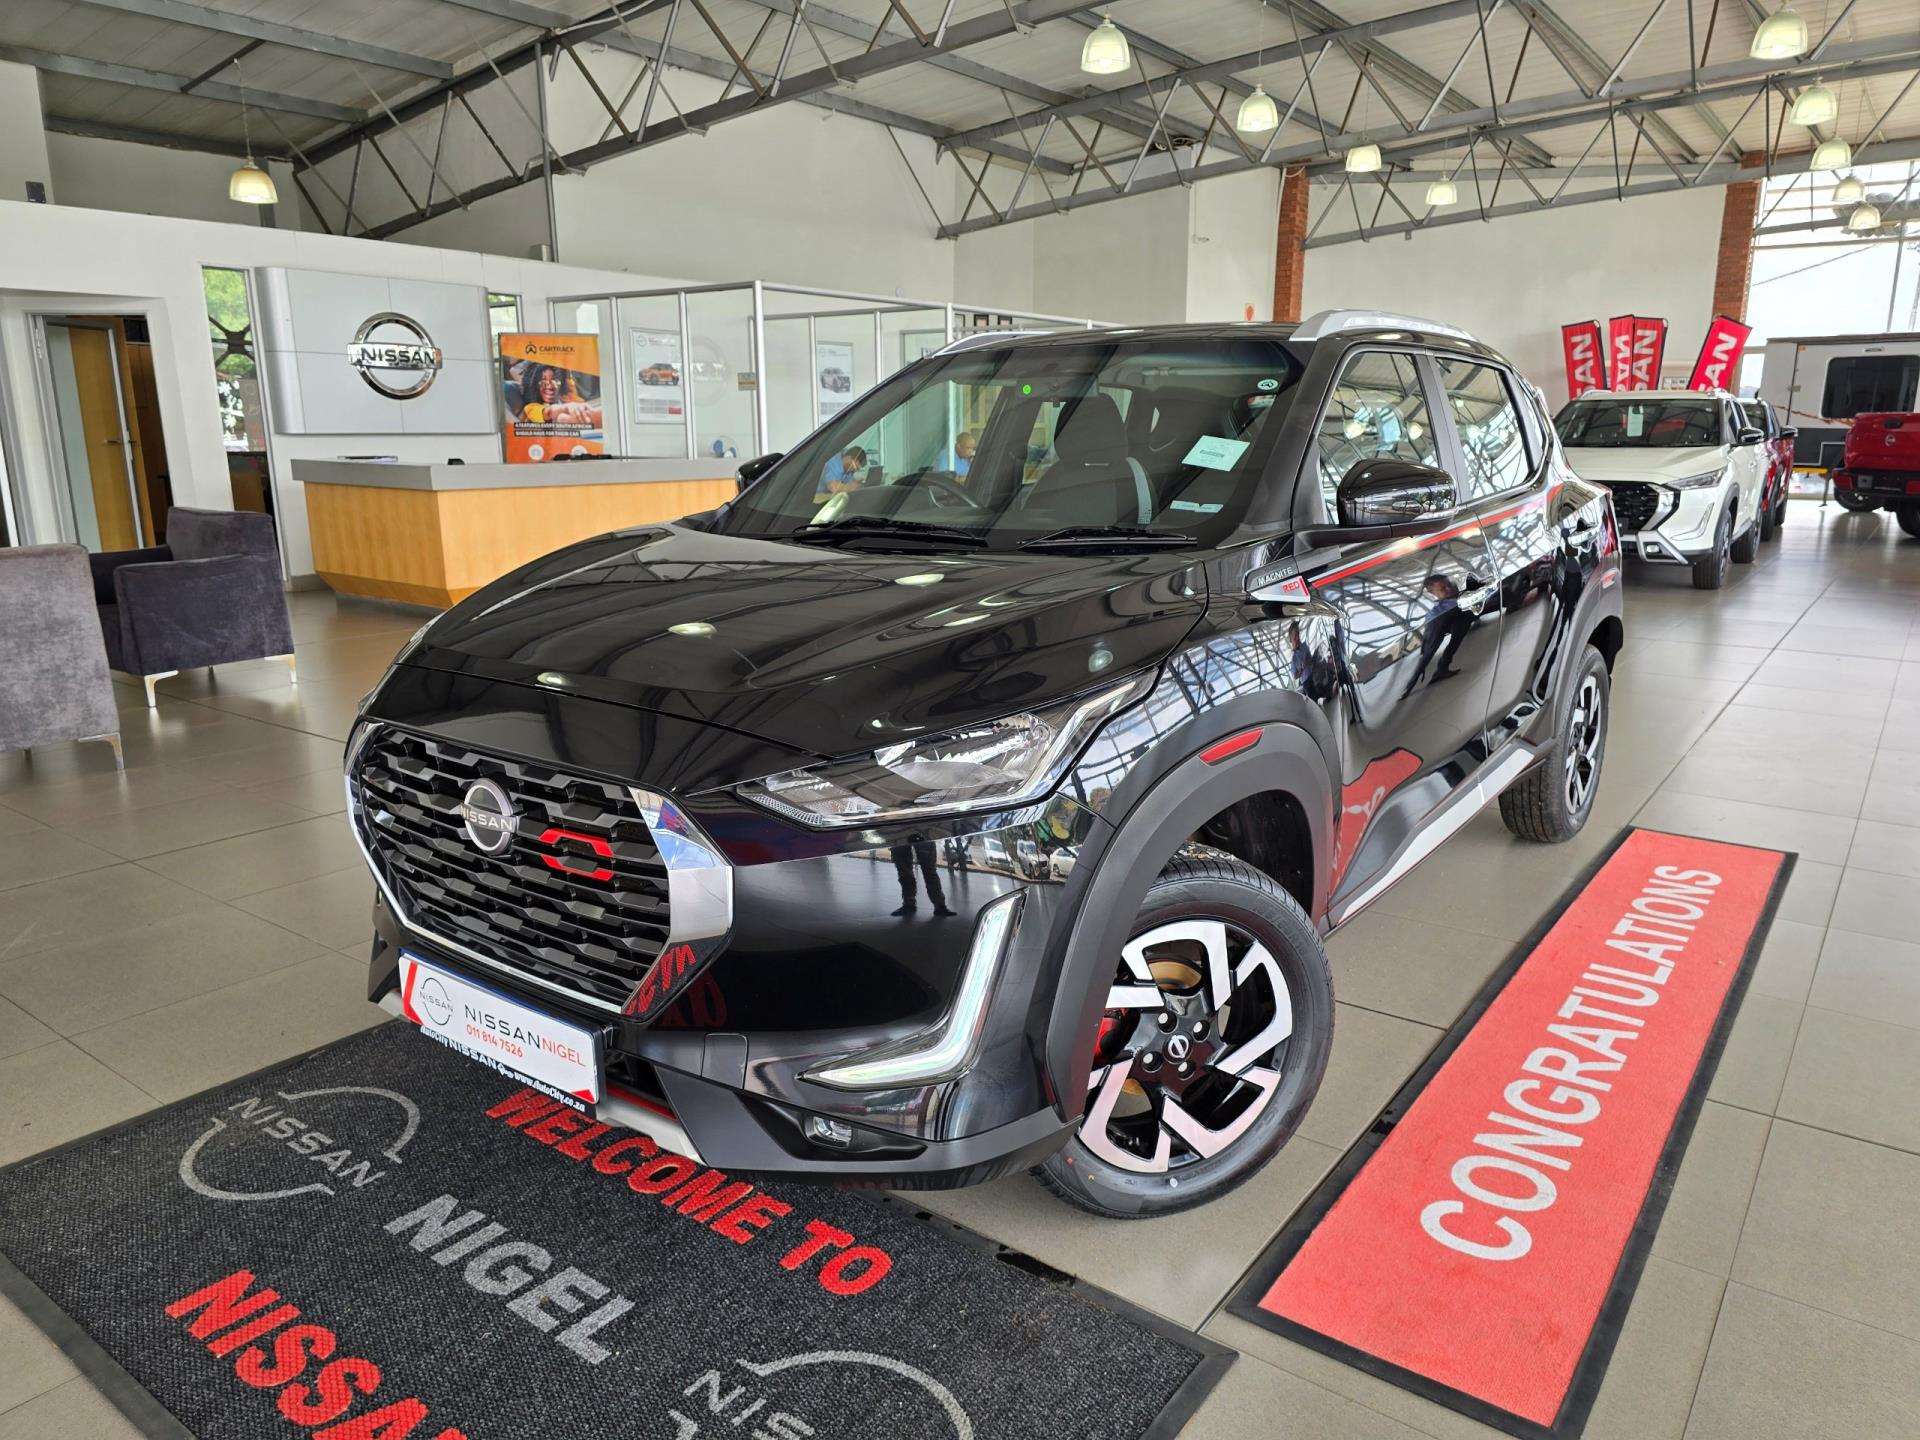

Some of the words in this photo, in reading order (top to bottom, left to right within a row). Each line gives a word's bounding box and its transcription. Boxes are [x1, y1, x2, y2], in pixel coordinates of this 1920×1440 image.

[361, 347, 435, 364] NISSAN
[1257, 566, 1293, 586] MAGNITE
[460, 804, 513, 831] NISSAN
[419, 991, 454, 1012] NISSAN
[449, 1039, 498, 1071] NISSAN
[466, 1024, 481, 1039] 011
[482, 1031, 498, 1047] 814
[499, 1040, 524, 1059] 7526
[1420, 866, 1722, 1260] CONGRATULATIONS
[228, 1095, 388, 1190] NISSAN
[485, 1087, 793, 1246] WELCOME
[779, 1217, 893, 1297] TO
[382, 1193, 637, 1366] NIGEL
[164, 1269, 468, 1440] NISSA
